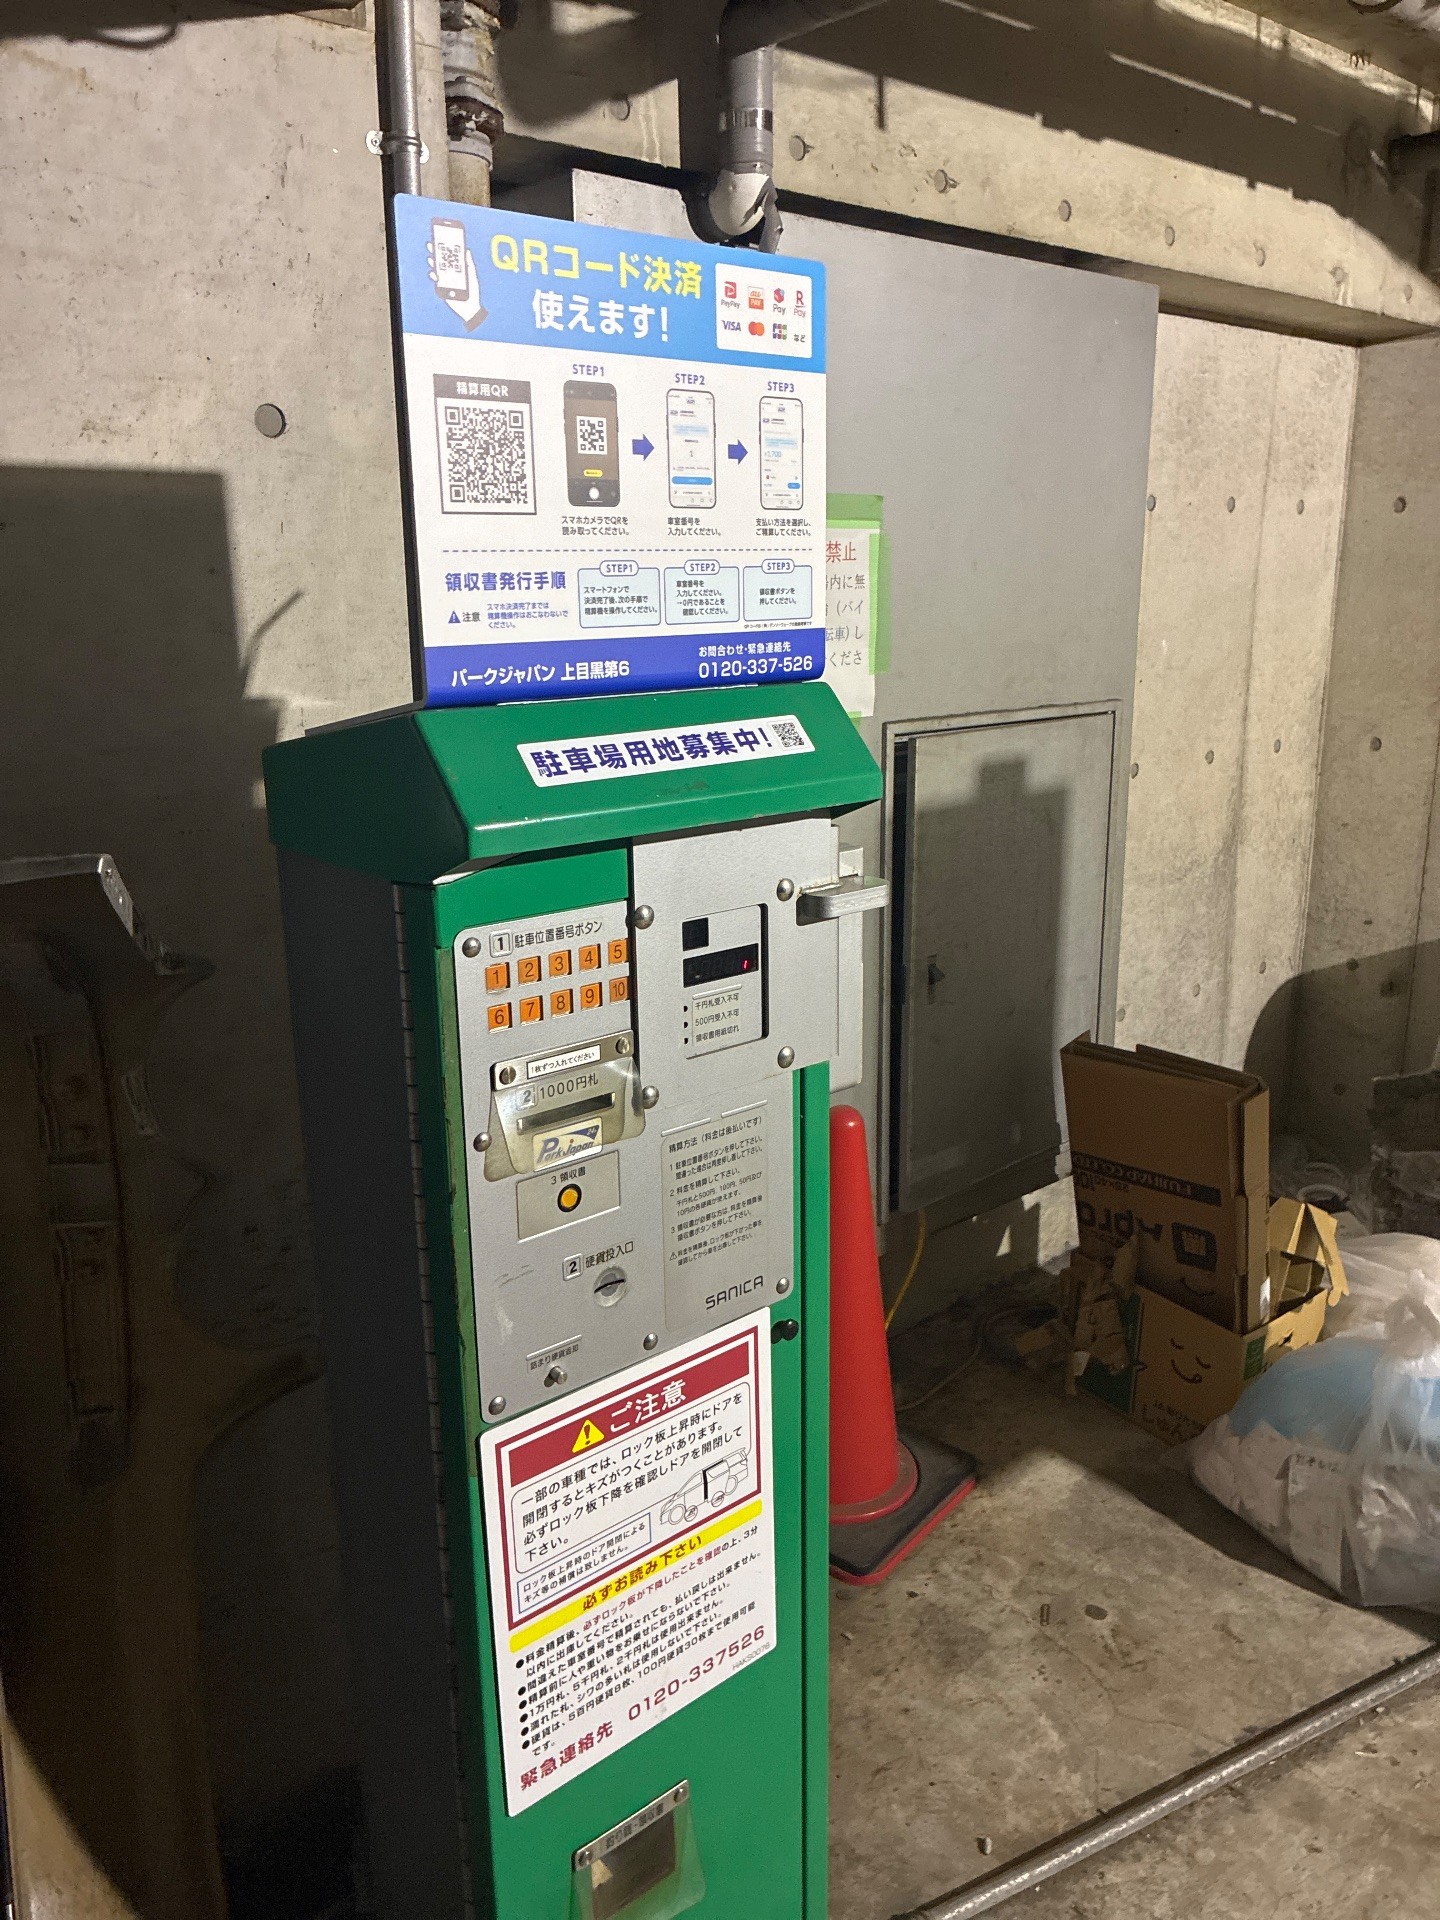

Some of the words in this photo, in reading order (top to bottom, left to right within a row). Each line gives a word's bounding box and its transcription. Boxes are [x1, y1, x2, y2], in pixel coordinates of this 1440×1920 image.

[490, 234, 703, 299] QRコード決済
[796, 290, 804, 305] R
[773, 304, 786, 315] Pay
[721, 320, 741, 331] VISA
[572, 363, 605, 377] STEP1
[674, 373, 706, 386] STEP2
[767, 381, 795, 393] STEP3
[456, 381, 510, 398] 精算用QR
[561, 516, 629, 525] スマホカメラでQRを
[667, 517, 701, 526] 車室番号を
[755, 518, 811, 527] 支払い方法を選択し、
[562, 526, 630, 536] 読み取ってください。
[667, 527, 721, 536] 入力してください。
[755, 528, 812, 537] ご精算してください。
[605, 563, 633, 574] STEP1
[689, 562, 716, 572] STEP2
[766, 561, 791, 571] STEP3
[445, 570, 567, 592] 領収書発行手順
[583, 585, 630, 594] スマートフォンで
[676, 579, 705, 588] 車室番号を
[826, 573, 866, 590] 内に無
[676, 589, 723, 597] 入力してください。
[759, 587, 796, 596] 領収書ボタンを
[487, 602, 550, 611] スマホ決済完了までは
[759, 596, 797, 605] 押してください。
[462, 611, 481, 623] 注意
[584, 606, 658, 615] 精算機を操作してください。
[682, 607, 729, 616] 確認してください。
[488, 621, 516, 629] ください。
[451, 663, 556, 687] パークジャパン
[560, 660, 630, 681] 上目黒第6
[698, 655, 813, 679] 0120-337-526
[499, 937, 505, 951] 1
[514, 921, 603, 949] 駐車位置番号ボタン
[493, 969, 500, 980] 1
[524, 962, 534, 978] 2
[554, 955, 564, 971] 3
[584, 950, 593, 965] 4
[614, 944, 623, 959] 5
[494, 1009, 505, 1025] 6
[526, 1002, 535, 1018] 7
[556, 995, 566, 1011] 8
[585, 989, 595, 1004] 9
[613, 982, 625, 998] 10
[695, 992, 740, 1010] 千円札受入不可
[695, 1008, 740, 1027] 500円受入不可
[695, 1024, 740, 1042] 領収書用紙切れ
[530, 1051, 596, 1074] 1枚ずつ入れてください
[522, 1089, 532, 1104] 2
[539, 1072, 599, 1100] 1000円札
[536, 1137, 563, 1164] Park
[551, 1175, 557, 1185] 3
[560, 1166, 586, 1182] 領収書
[669, 1188, 675, 1197] 2
[670, 1226, 676, 1234] 3
[569, 1261, 577, 1274] 2
[585, 1241, 634, 1269] 硬貨投入口
[705, 1275, 764, 1311] SANICA
[609, 1377, 687, 1434] ご注意
[520, 1392, 743, 1506] 一部の車種では、ロック板上昇時にドアを
[522, 1424, 723, 1528] 開閉するとキズがつくことがあります。
[523, 1425, 743, 1547] 必ずロック板下降を確認しドアを開閉して
[523, 1522, 646, 1593] ロック板上昇時のドア開閉による
[525, 1536, 569, 1563] 下さい。
[524, 1545, 629, 1603] キズ等の補償は致しません。
[582, 1535, 703, 1612] 必ずお読み下さい
[527, 1551, 762, 1692] 間違えた車室番号で精算されても、払い戻しは出来ません。
[526, 1612, 634, 1678] 以内に出庫してください。
[528, 1583, 731, 1705] 精算前に人や重い物をお乗せにならないで下さい。
[519, 1720, 614, 1791] 緊急連絡先
[628, 1624, 765, 1722] 0120-337526
[531, 1740, 556, 1756] です。
